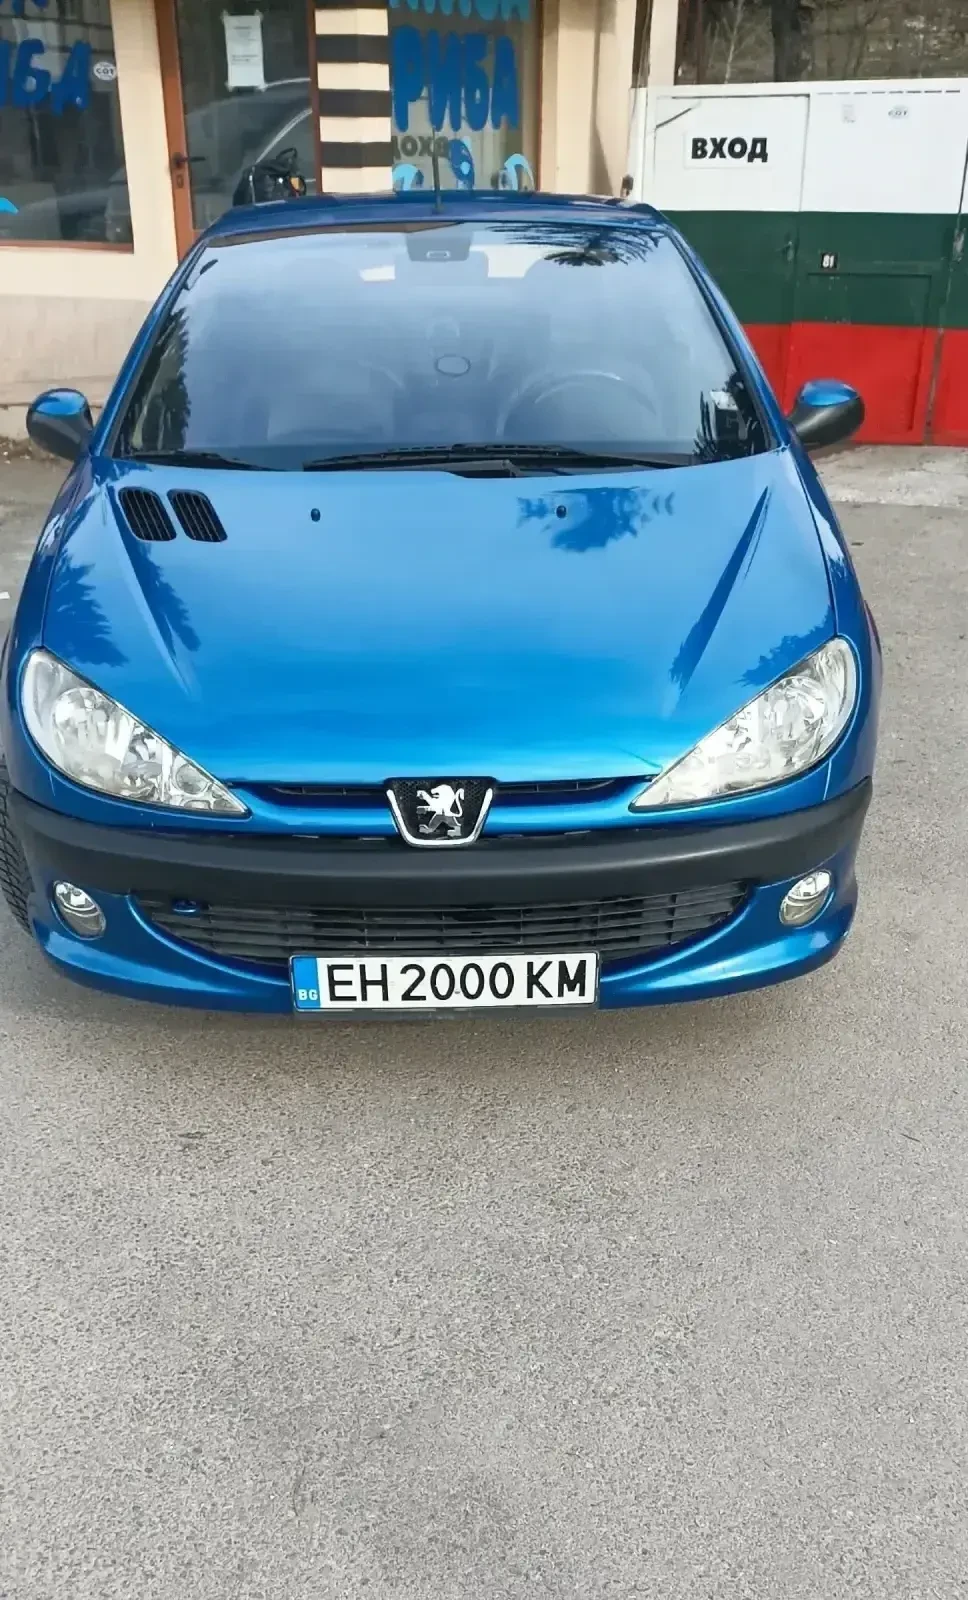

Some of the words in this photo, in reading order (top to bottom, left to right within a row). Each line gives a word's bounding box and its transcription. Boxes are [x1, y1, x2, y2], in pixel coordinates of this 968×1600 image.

[0, 38, 92, 116] БА
[393, 25, 520, 132] РИБА
[691, 137, 768, 163] ВХОД
[298, 989, 318, 1000] BG
[327, 963, 389, 1002] EH
[400, 962, 515, 1001] 2000
[526, 959, 587, 999] KM
